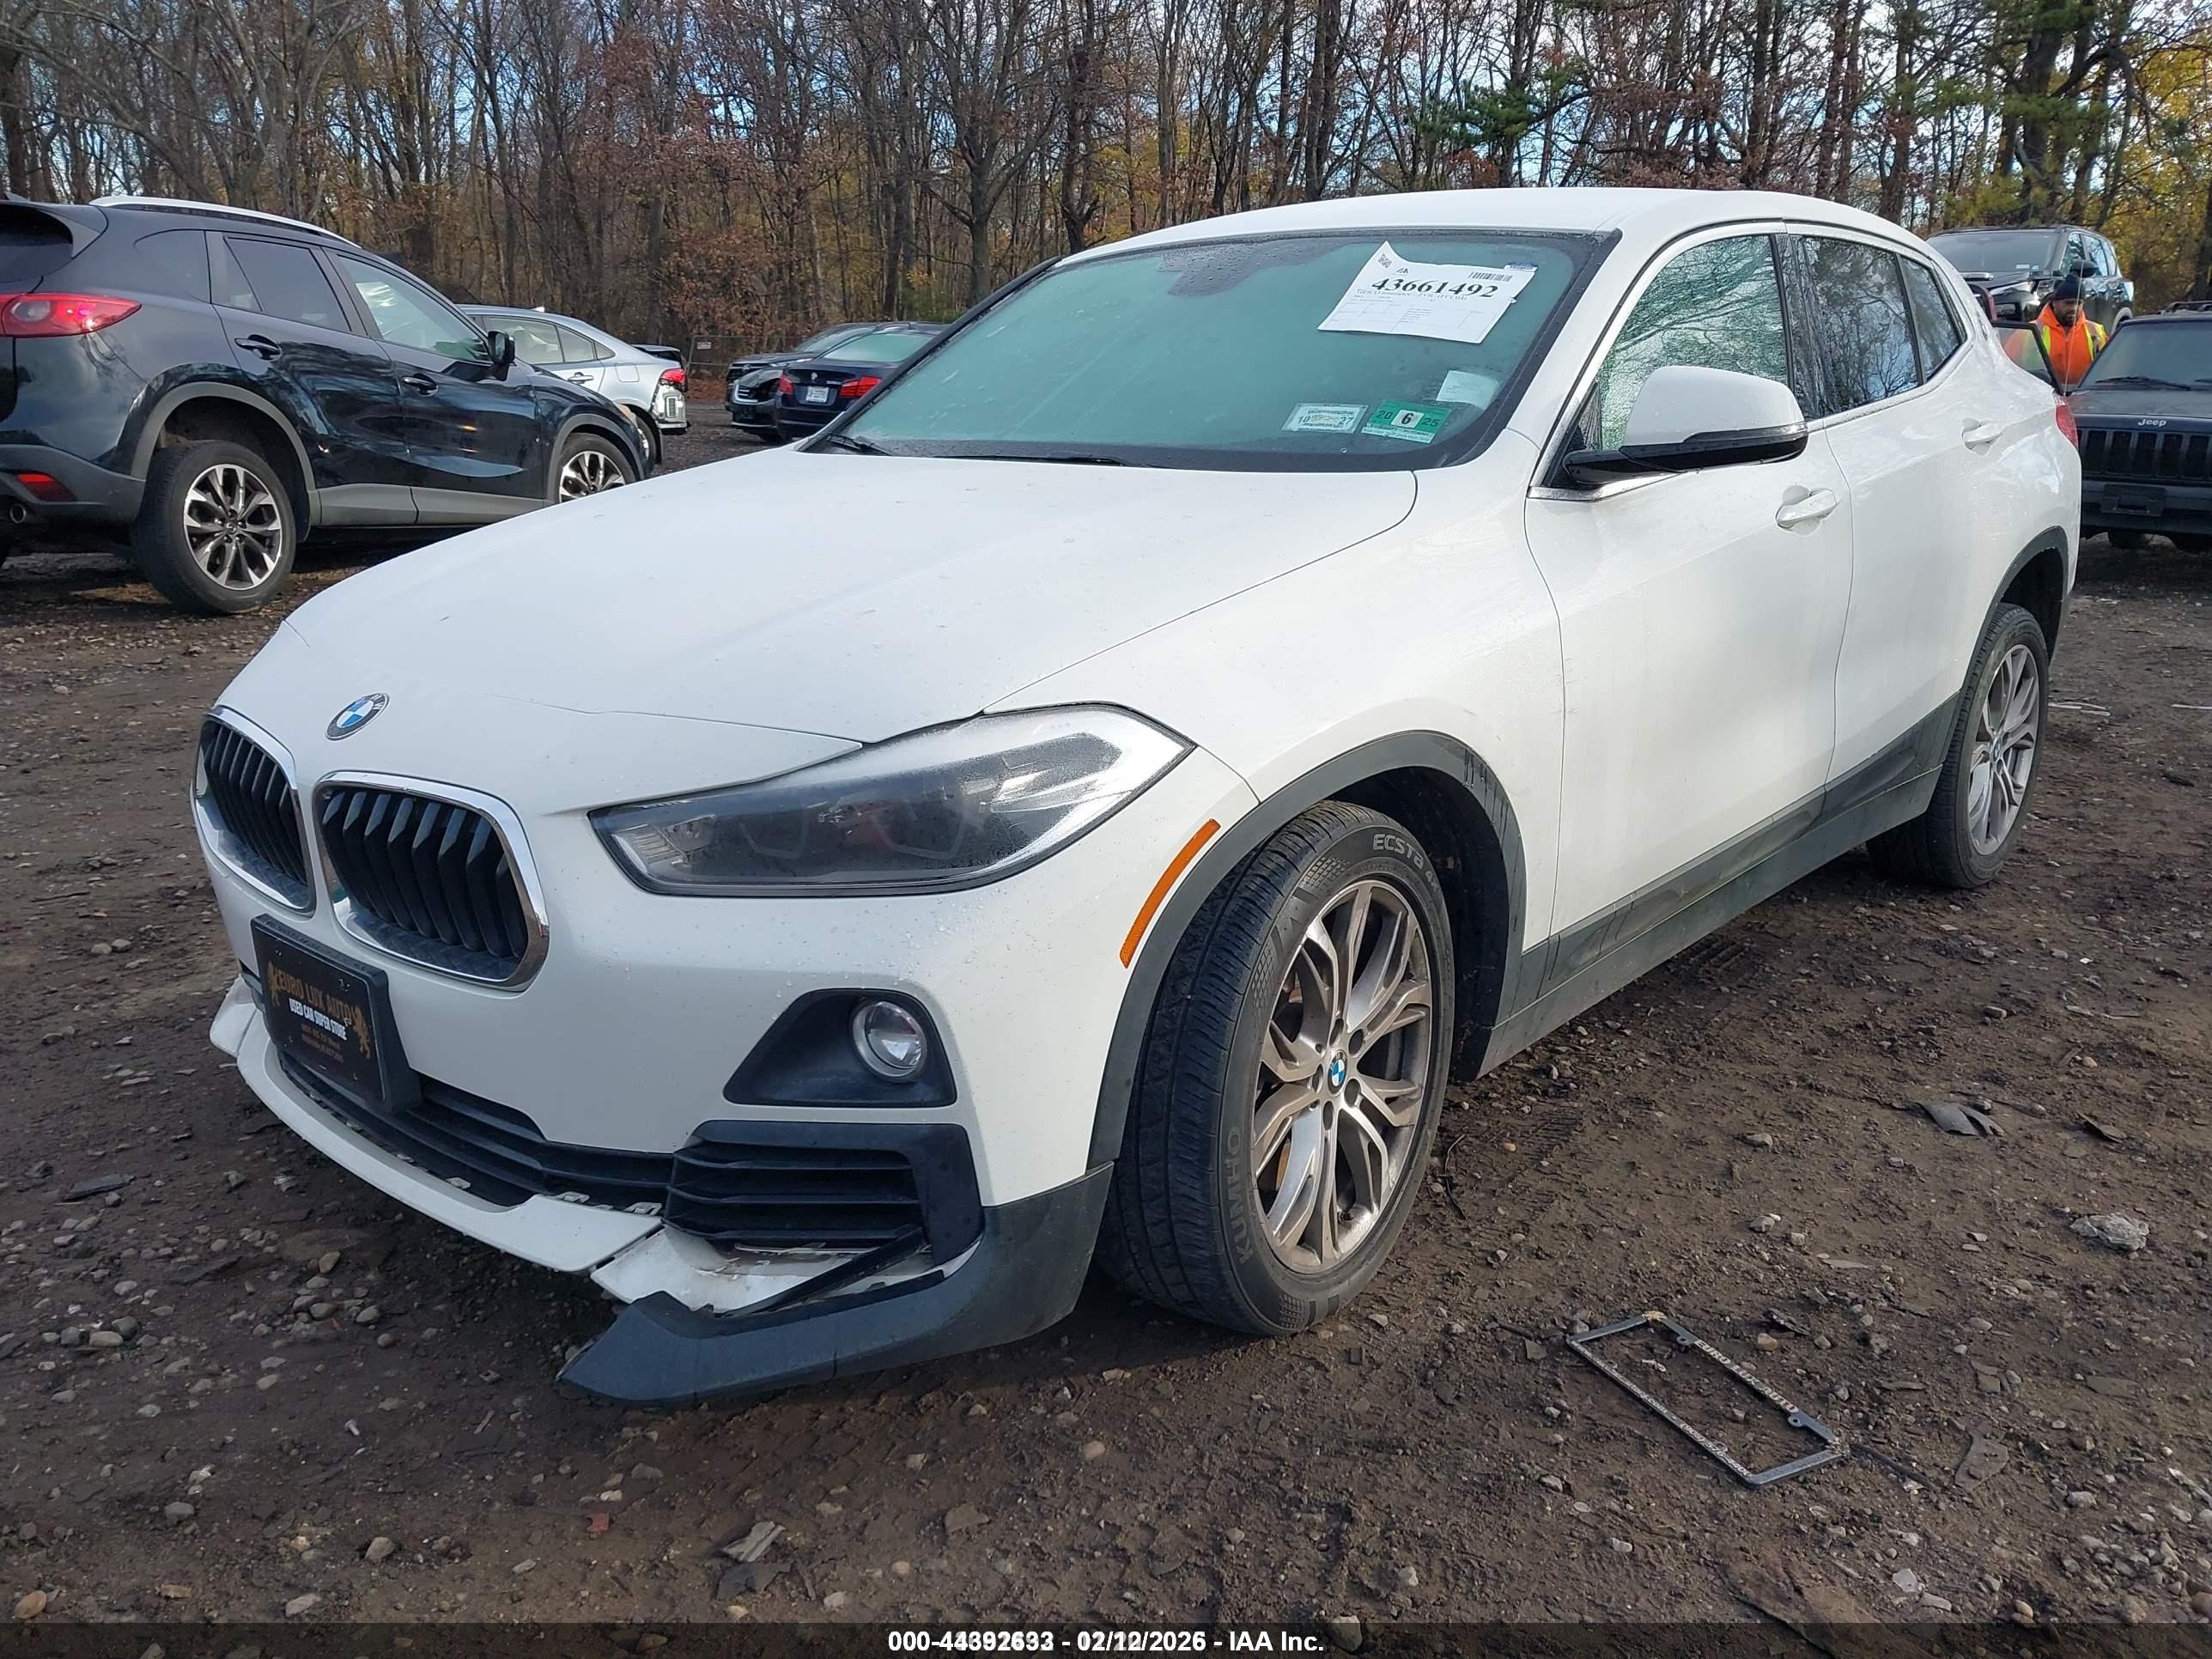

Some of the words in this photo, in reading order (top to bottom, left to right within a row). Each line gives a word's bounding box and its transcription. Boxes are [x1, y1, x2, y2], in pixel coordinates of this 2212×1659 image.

[1371, 277, 1498, 298] 43661492
[1338, 416, 1353, 426] 27
[1376, 410, 1394, 420] 20
[1401, 412, 1413, 424] 6
[1421, 416, 1440, 428] 25
[2137, 418, 2166, 428] Jeep
[289, 997, 303, 1017] USED
[303, 1004, 315, 1023] CAR
[313, 1010, 331, 1031] SUPER
[1224, 1127, 1253, 1265] KUMHO
[1694, 1339, 1731, 1364] EURO
[1731, 1364, 1765, 1392] LUX
[1764, 1386, 1799, 1413] AUTO
